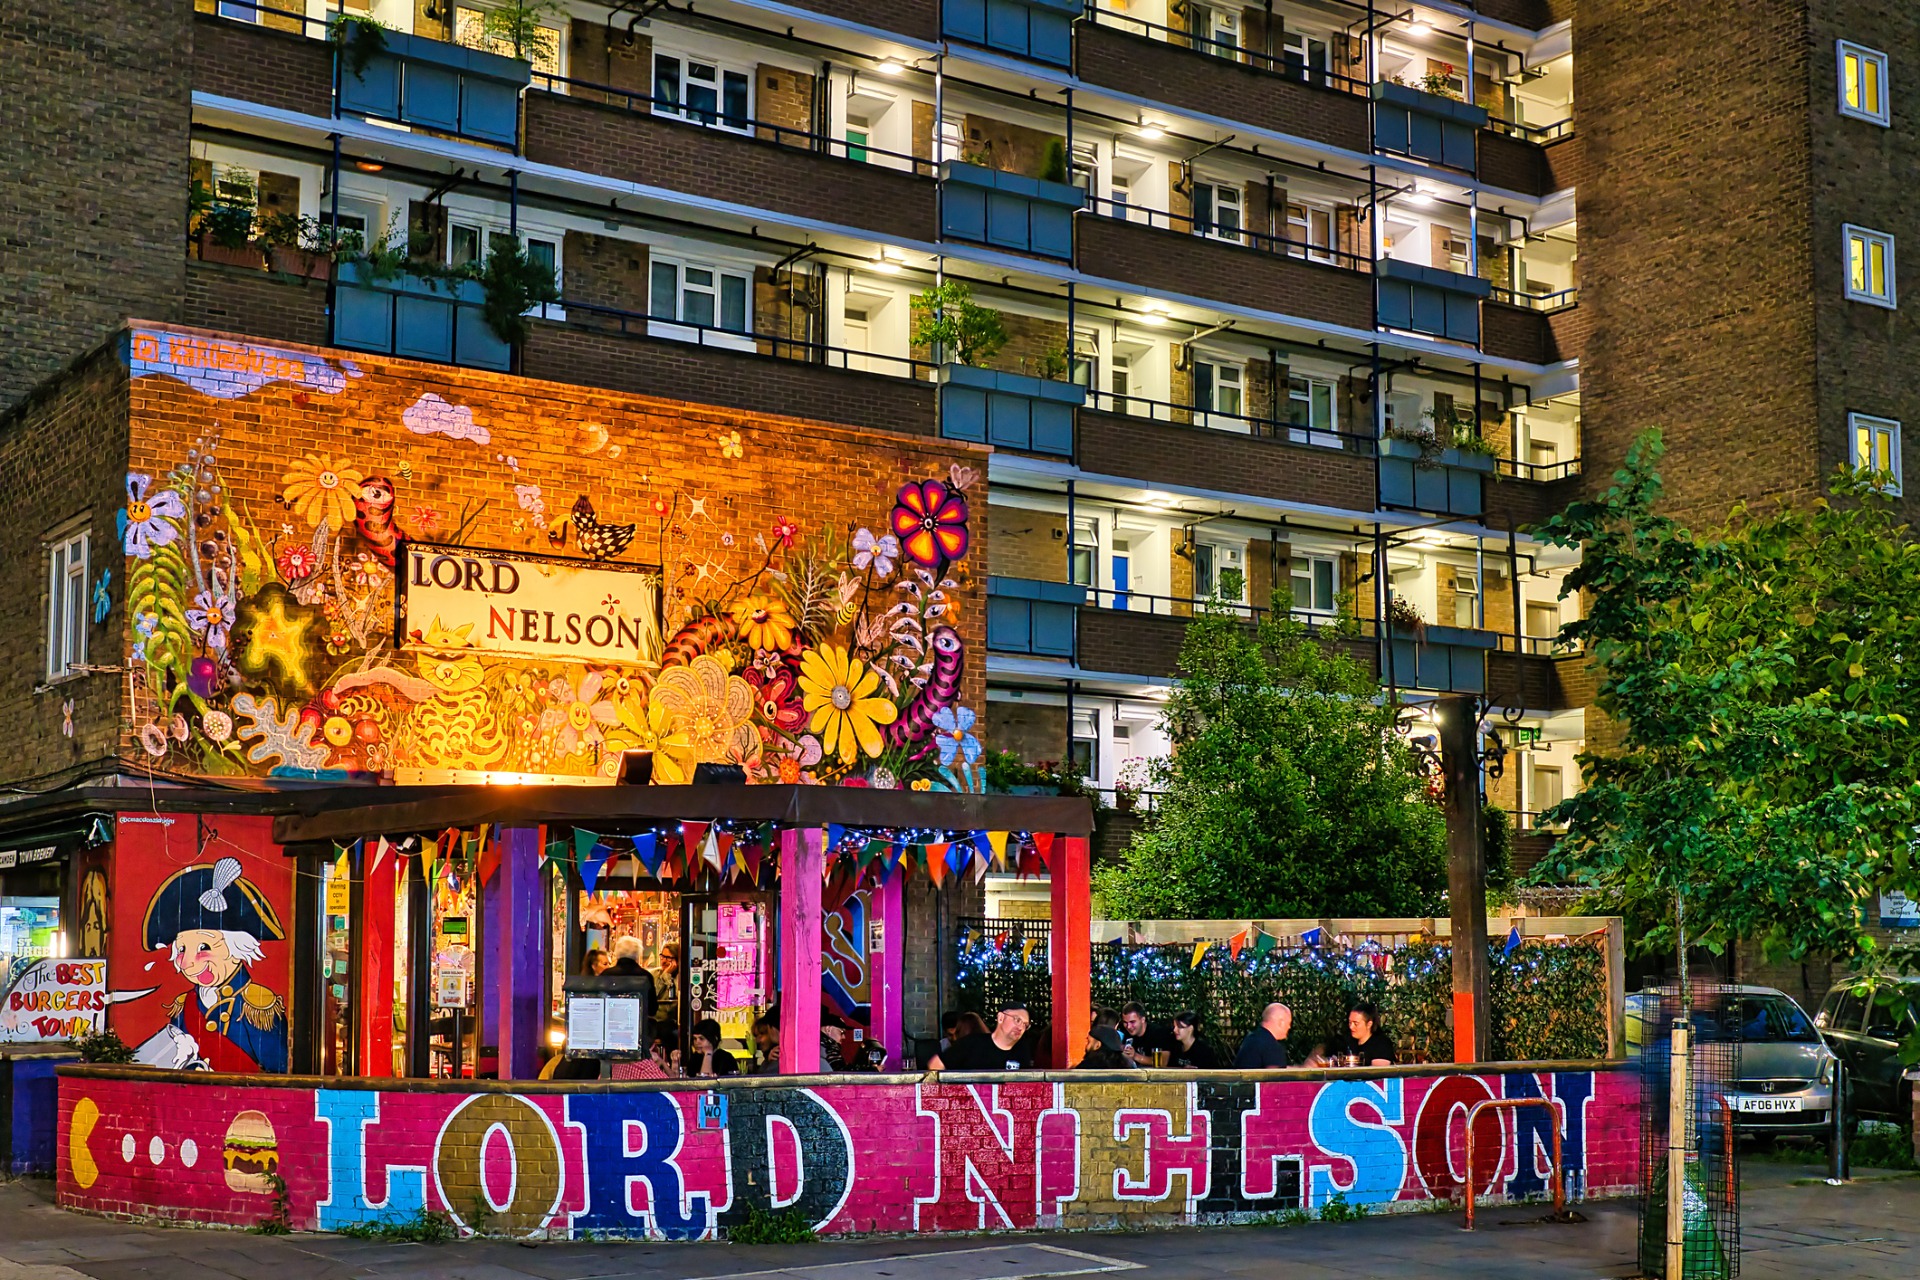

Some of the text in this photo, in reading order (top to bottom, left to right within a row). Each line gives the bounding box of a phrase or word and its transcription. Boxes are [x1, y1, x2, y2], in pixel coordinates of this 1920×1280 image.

[410, 552, 520, 594] LORD
[487, 604, 642, 650] NELSON
[19, 850, 34, 864] TOWN
[23, 962, 105, 991] The BEST
[10, 990, 105, 1012] BURGERS
[31, 1012, 98, 1039] TOWN!
[703, 1105, 722, 1118] WO
[1743, 1100, 1796, 1110] AF06 HVX
[314, 1070, 1596, 1241] LORD NELSON
